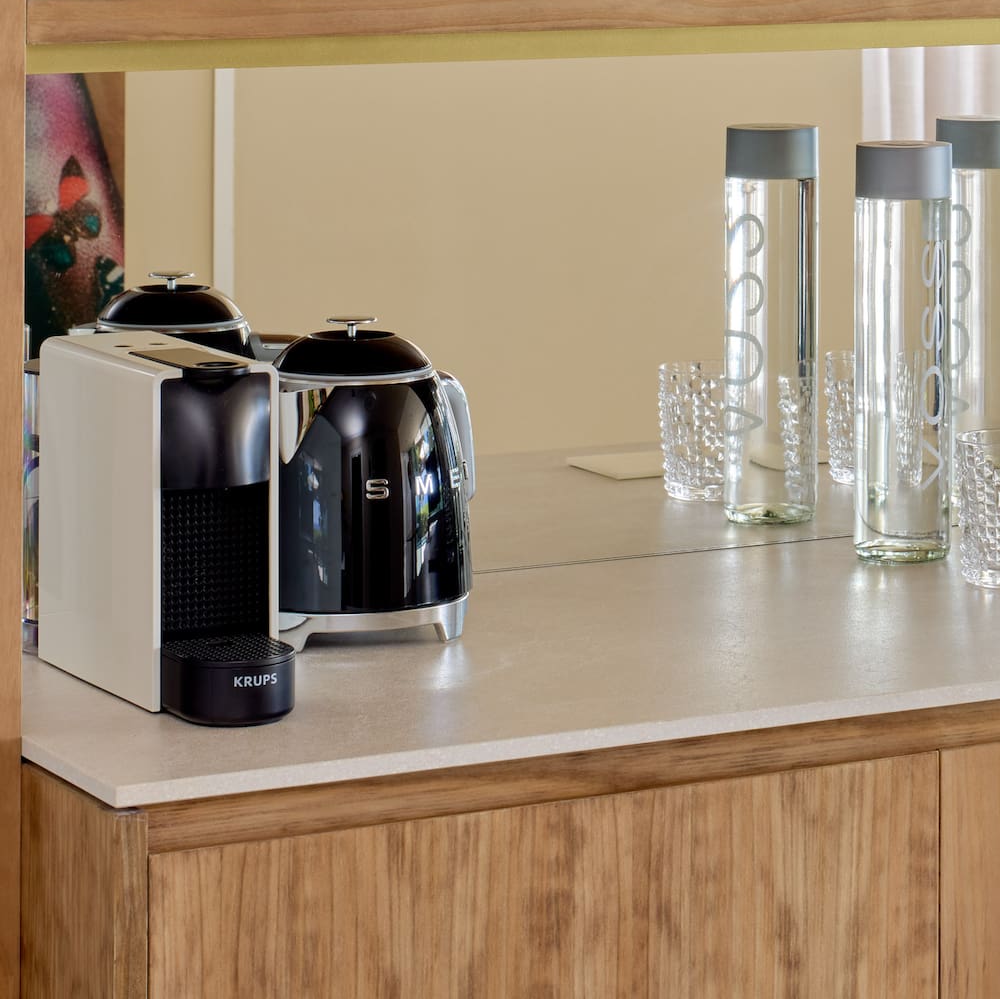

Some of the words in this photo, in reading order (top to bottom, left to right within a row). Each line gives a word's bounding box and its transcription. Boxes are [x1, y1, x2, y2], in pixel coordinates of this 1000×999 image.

[920, 239, 945, 490] VOSS
[366, 460, 469, 500] SME
[233, 672, 278, 688] KRUPS
